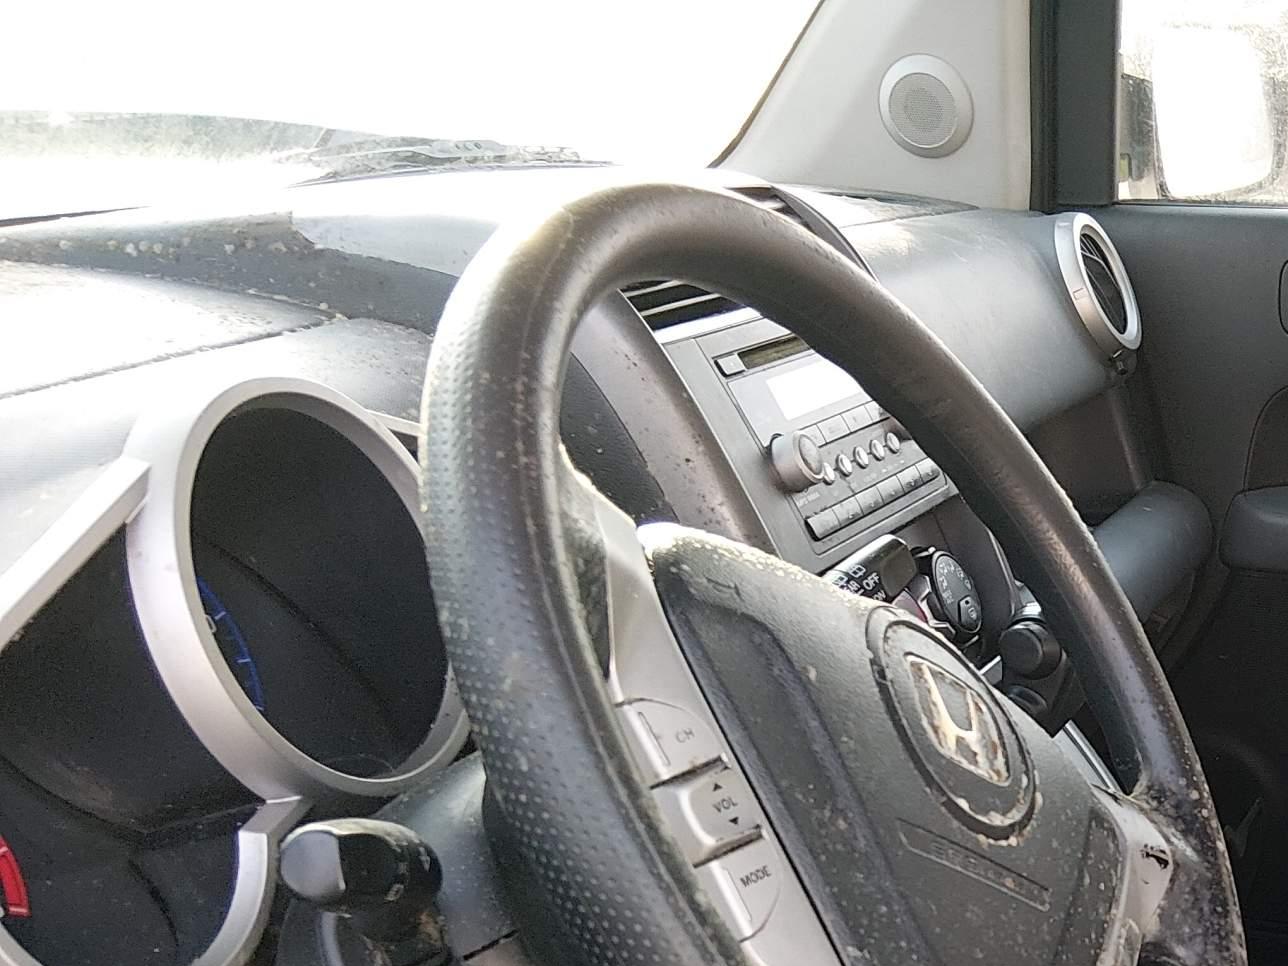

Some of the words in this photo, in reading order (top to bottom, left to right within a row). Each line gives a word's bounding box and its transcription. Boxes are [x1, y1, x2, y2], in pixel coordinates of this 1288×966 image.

[863, 573, 880, 590] OFF
[676, 729, 695, 743] CH
[712, 797, 738, 813] VOL
[741, 865, 771, 888] MODE
